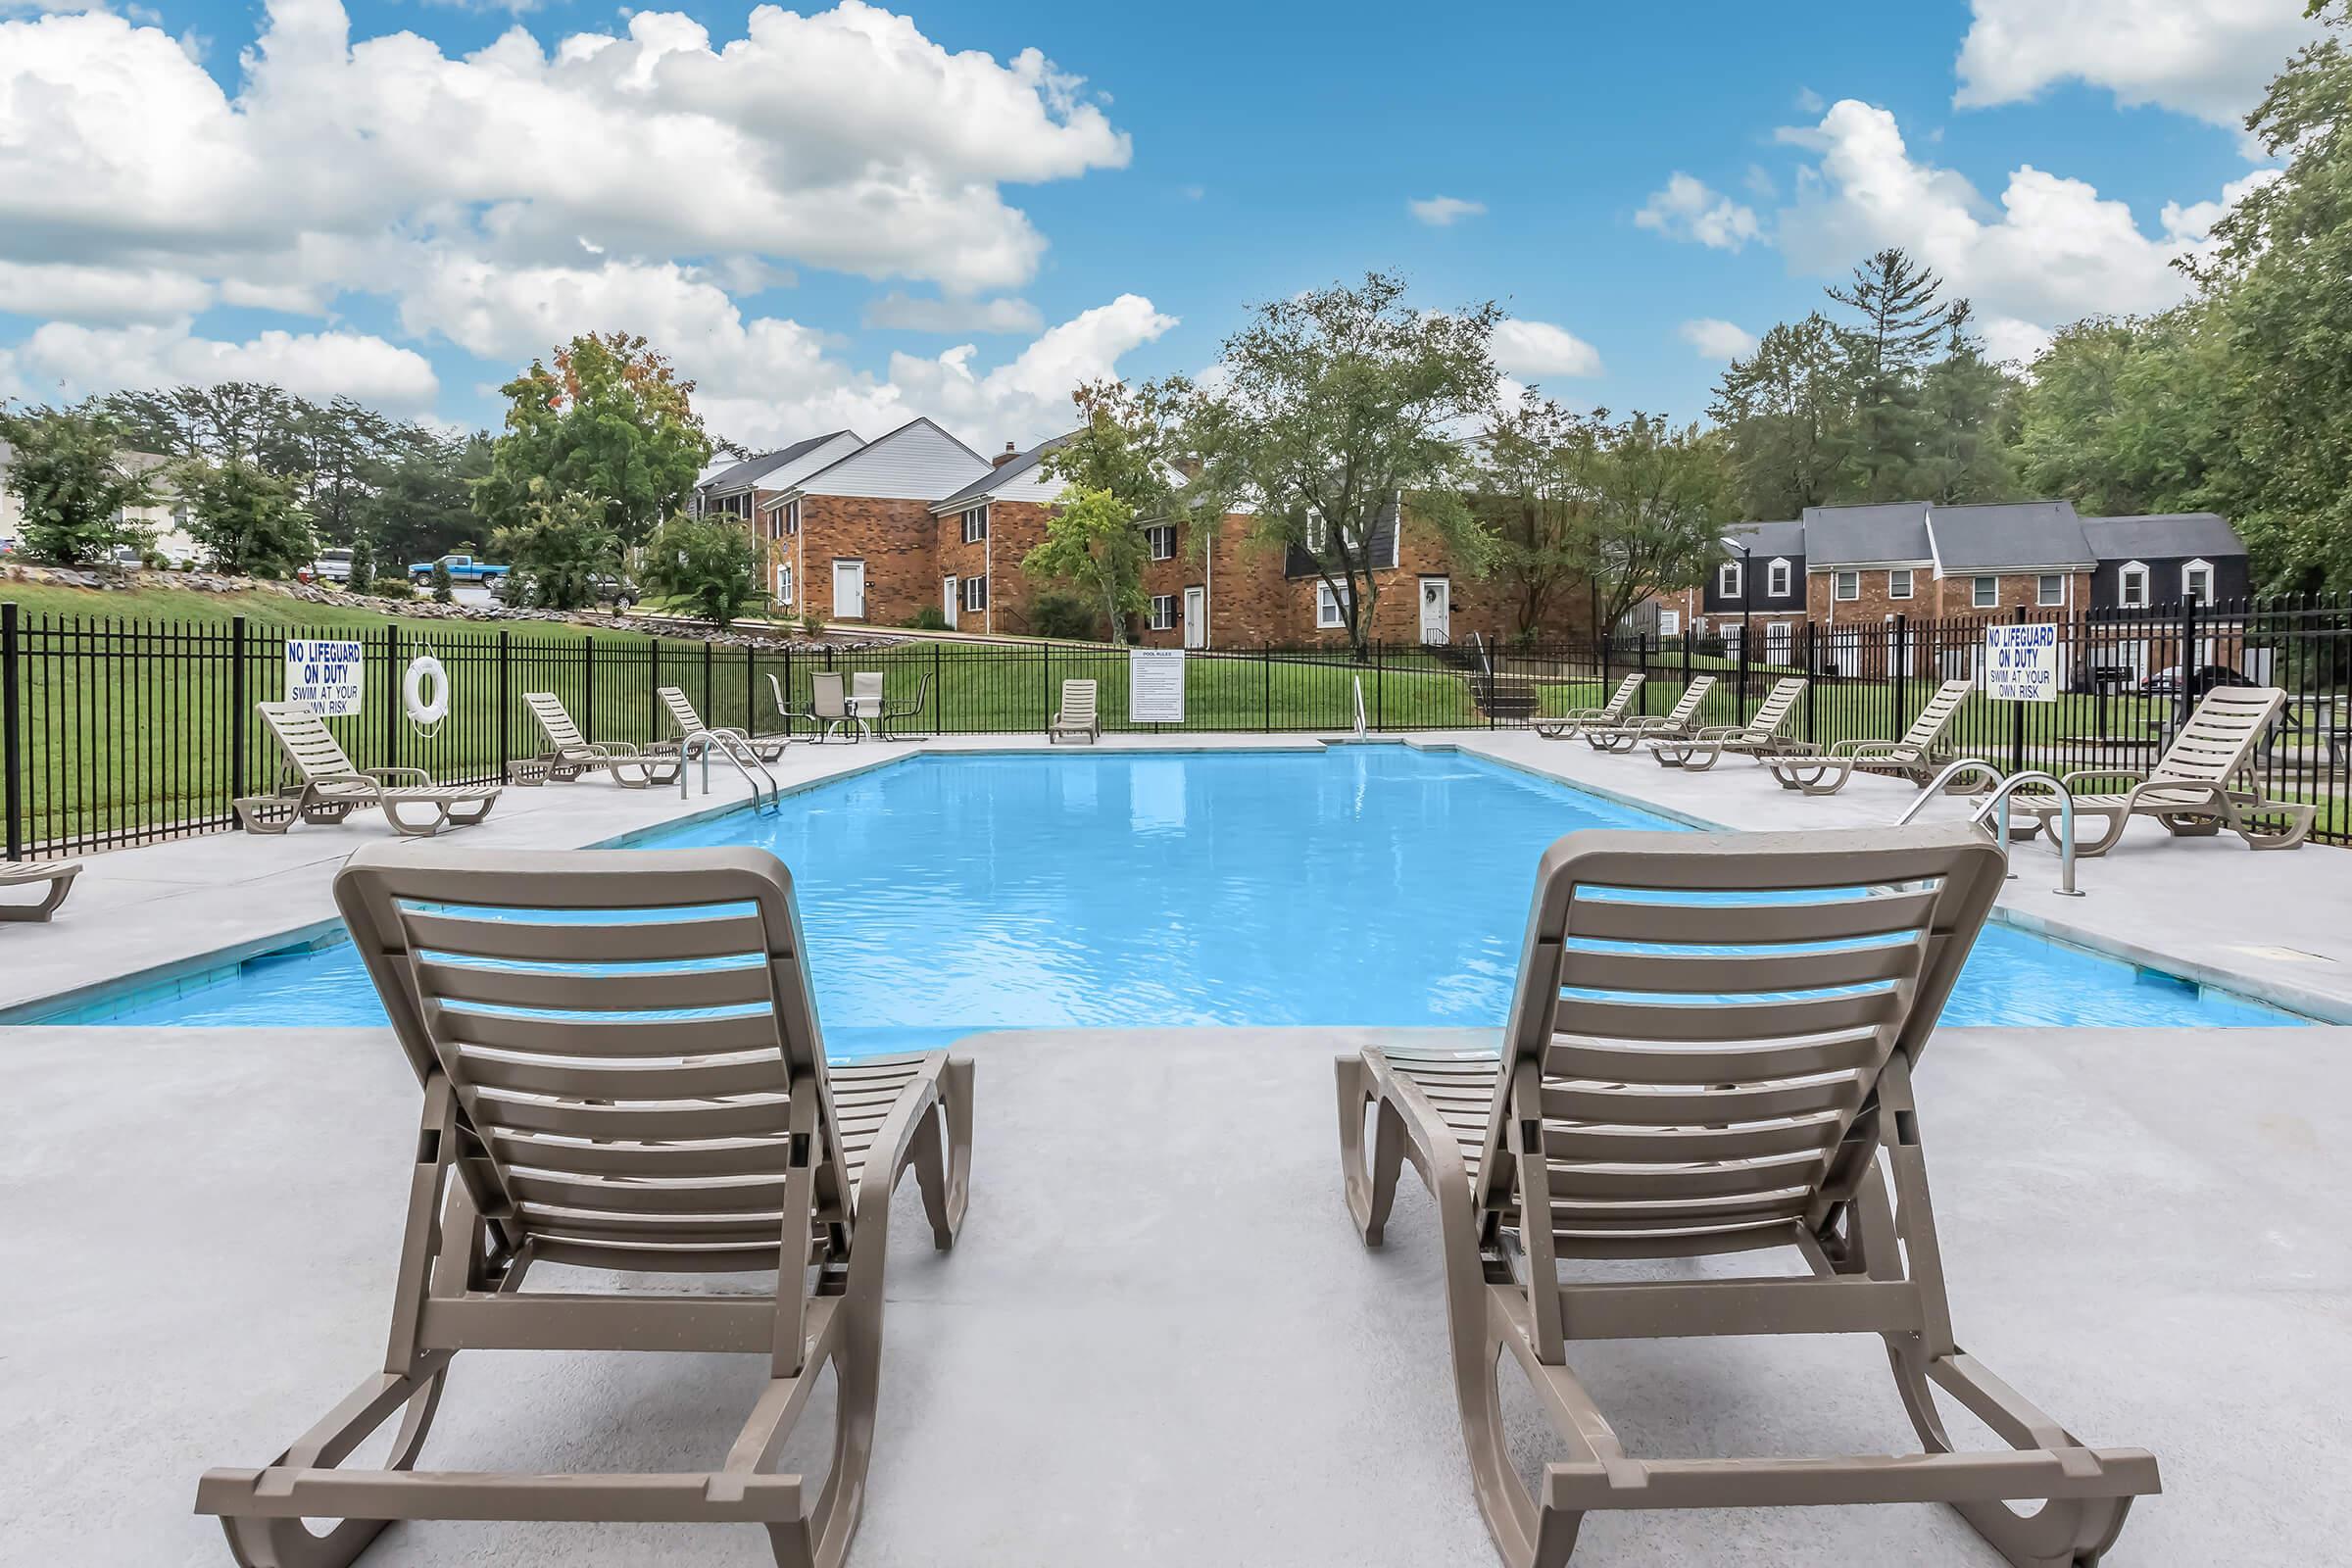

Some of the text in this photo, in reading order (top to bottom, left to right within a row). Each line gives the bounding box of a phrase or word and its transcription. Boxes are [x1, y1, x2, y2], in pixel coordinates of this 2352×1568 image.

[1988, 627, 2053, 647] NO LIFEGUARD
[289, 643, 360, 663] NO LIFEGUARD
[1999, 649, 2037, 667] ON DUTY
[305, 664, 348, 684] ON DUTY
[1990, 670, 2049, 683] SWIM AT YOUR
[292, 686, 358, 701] SWIM AT YOUR
[1999, 684, 2038, 698] OWN RISK
[311, 701, 347, 714] WN RISK
